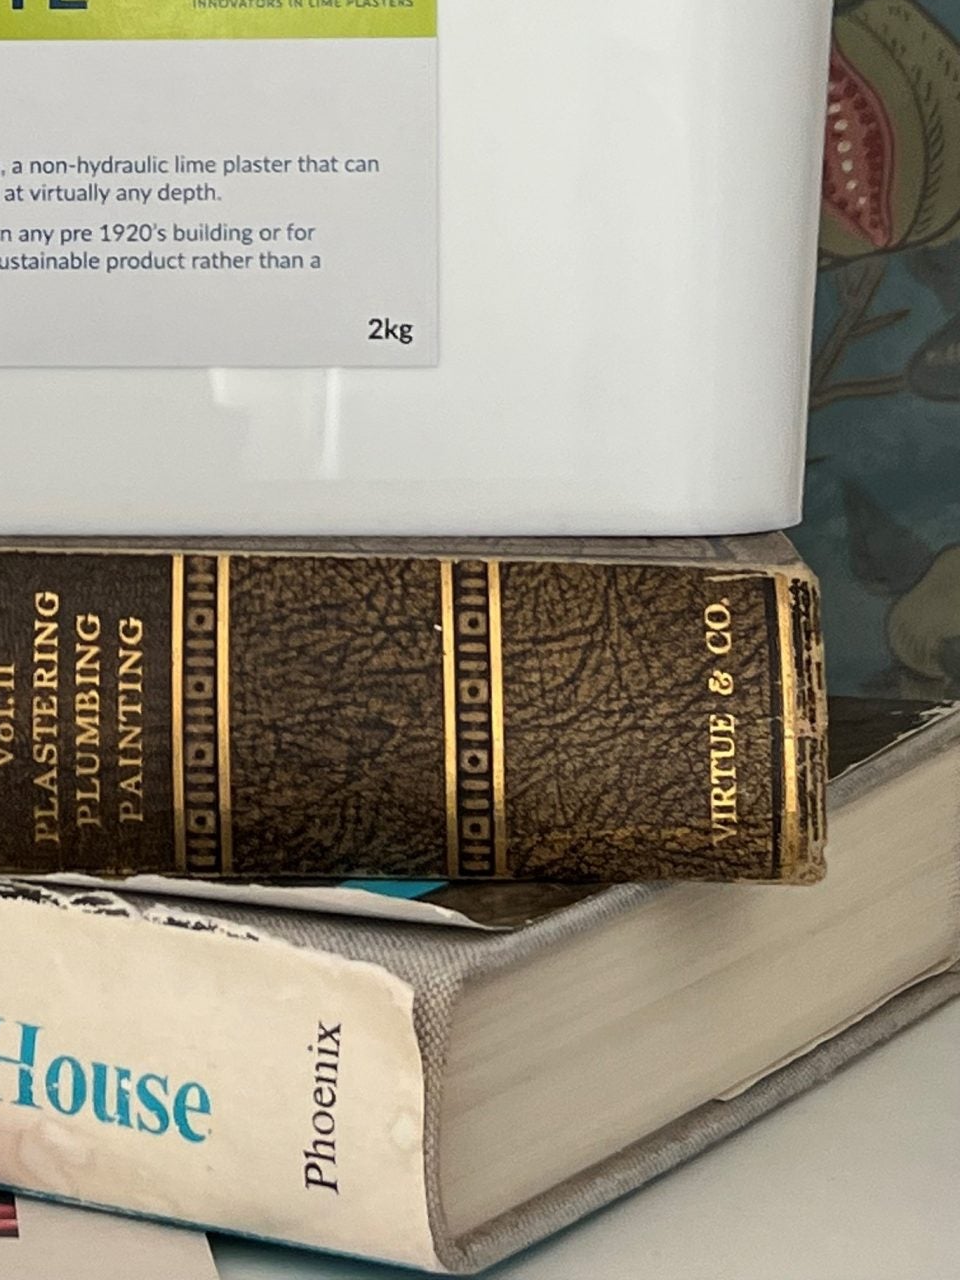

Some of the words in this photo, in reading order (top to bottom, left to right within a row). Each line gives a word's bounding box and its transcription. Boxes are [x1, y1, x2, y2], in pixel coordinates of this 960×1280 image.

[11, 160, 23, 175] a
[29, 154, 169, 178] non-hydraulic
[174, 154, 217, 174] lime
[223, 154, 293, 177] plaster
[297, 154, 339, 174] that
[344, 158, 380, 173] can
[3, 184, 25, 202] at
[29, 182, 111, 206] virtually
[115, 187, 153, 205] any
[157, 182, 222, 205] depth.
[17, 228, 55, 246] any
[60, 228, 93, 246] pre
[99, 223, 168, 243] 1920's
[172, 222, 254, 246] building
[258, 227, 282, 242] or
[286, 222, 316, 242] for
[106, 250, 186, 274] product
[191, 250, 254, 270] rather
[258, 250, 304, 270] than
[309, 255, 321, 269] a
[367, 317, 414, 345] 2kg
[704, 597, 732, 655] CO.
[708, 670, 735, 696] &
[32, 591, 60, 844] PLASTERING
[76, 613, 102, 827] PLUMBING
[118, 616, 144, 823] PAINTING
[709, 714, 739, 847] VIRTUE
[303, 1019, 343, 1196] Phoenix
